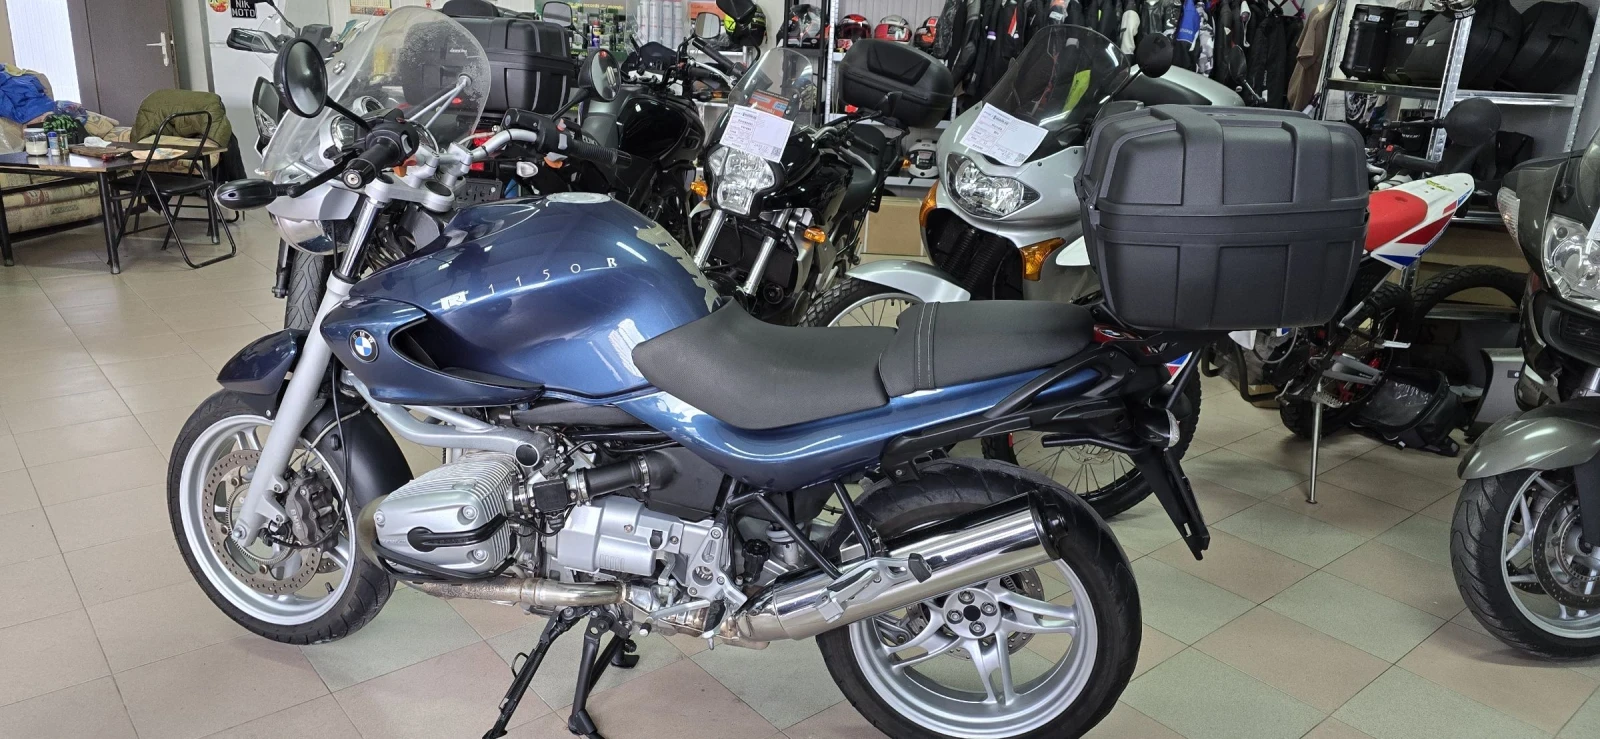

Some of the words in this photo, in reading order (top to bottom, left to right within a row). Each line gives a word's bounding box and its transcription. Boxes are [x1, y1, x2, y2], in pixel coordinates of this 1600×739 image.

[231, 8, 255, 17] MOTO
[569, 130, 600, 146] SZUKI
[352, 331, 374, 343] BMW
[290, 509, 301, 530] BMW
